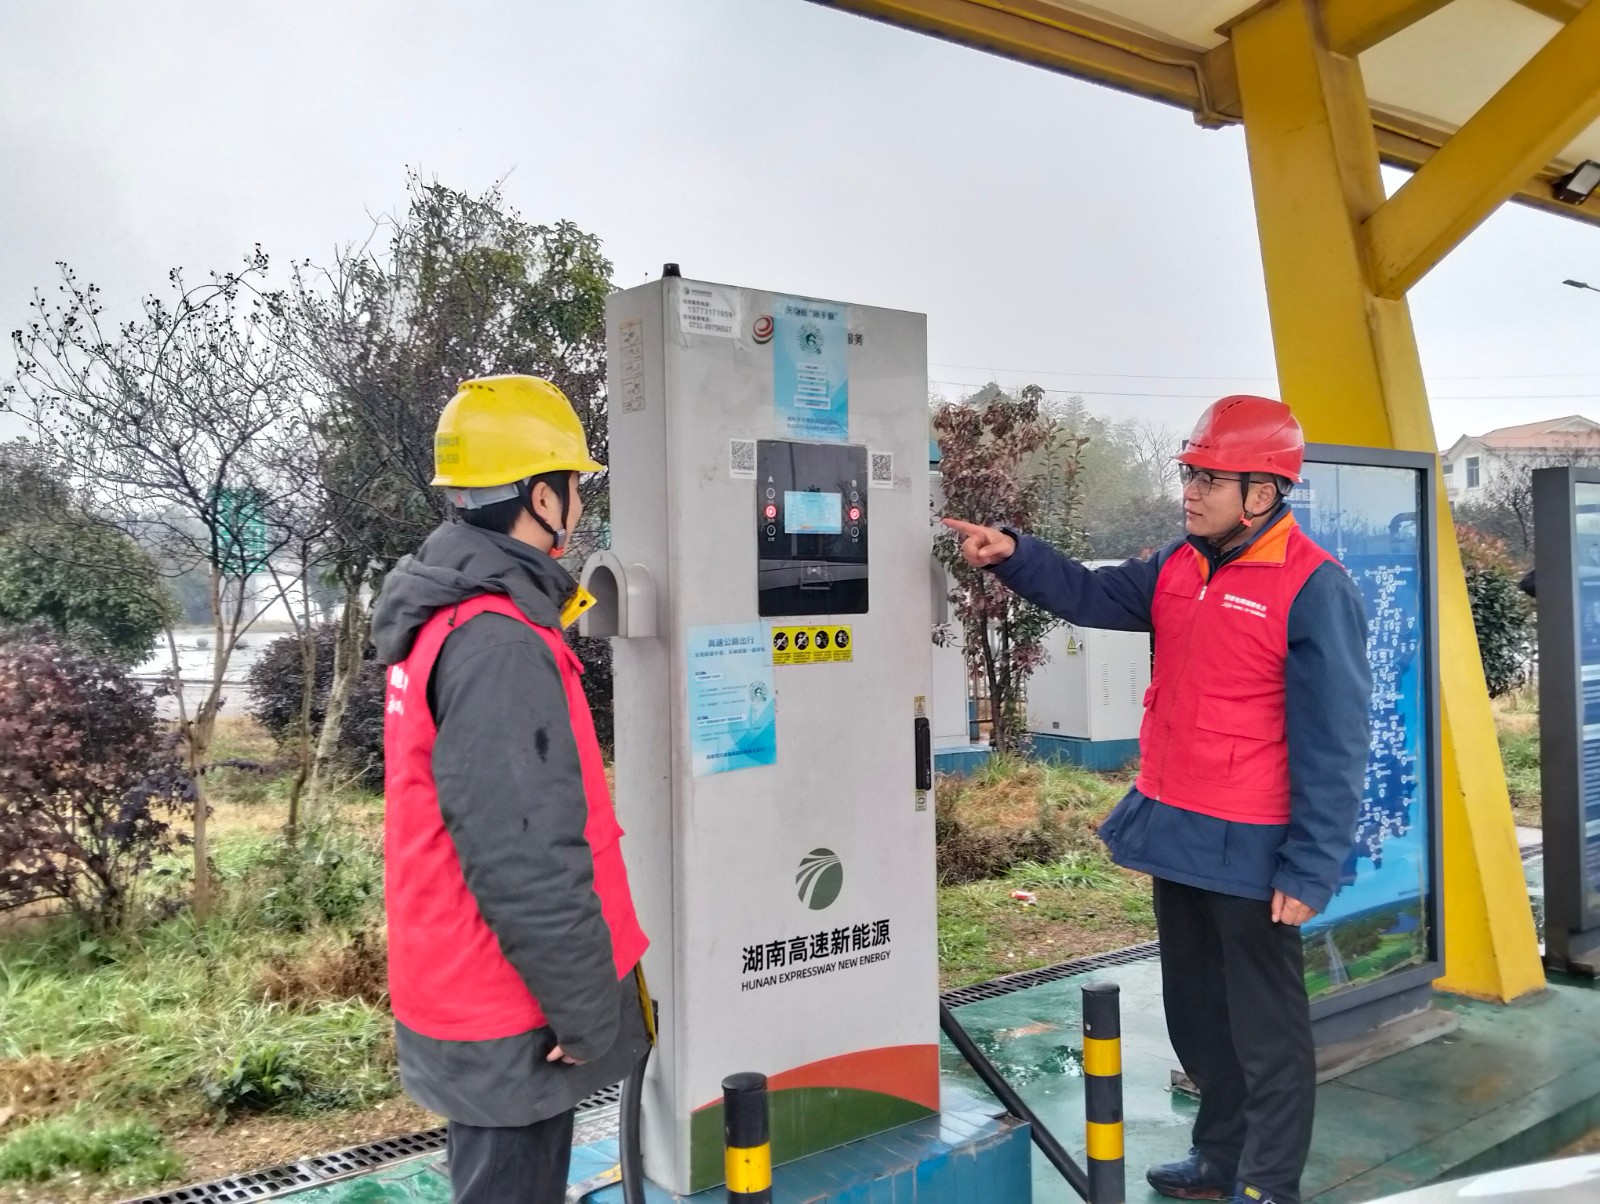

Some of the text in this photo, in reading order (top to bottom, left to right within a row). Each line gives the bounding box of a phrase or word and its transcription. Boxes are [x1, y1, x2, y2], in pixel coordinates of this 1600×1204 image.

[767, 475, 774, 483] A
[707, 636, 755, 648] 高速公路出行
[741, 918, 891, 974] 湖南高速新能源
[741, 950, 891, 992] HUNAN EXPRESSWAY NEW ENERGY
